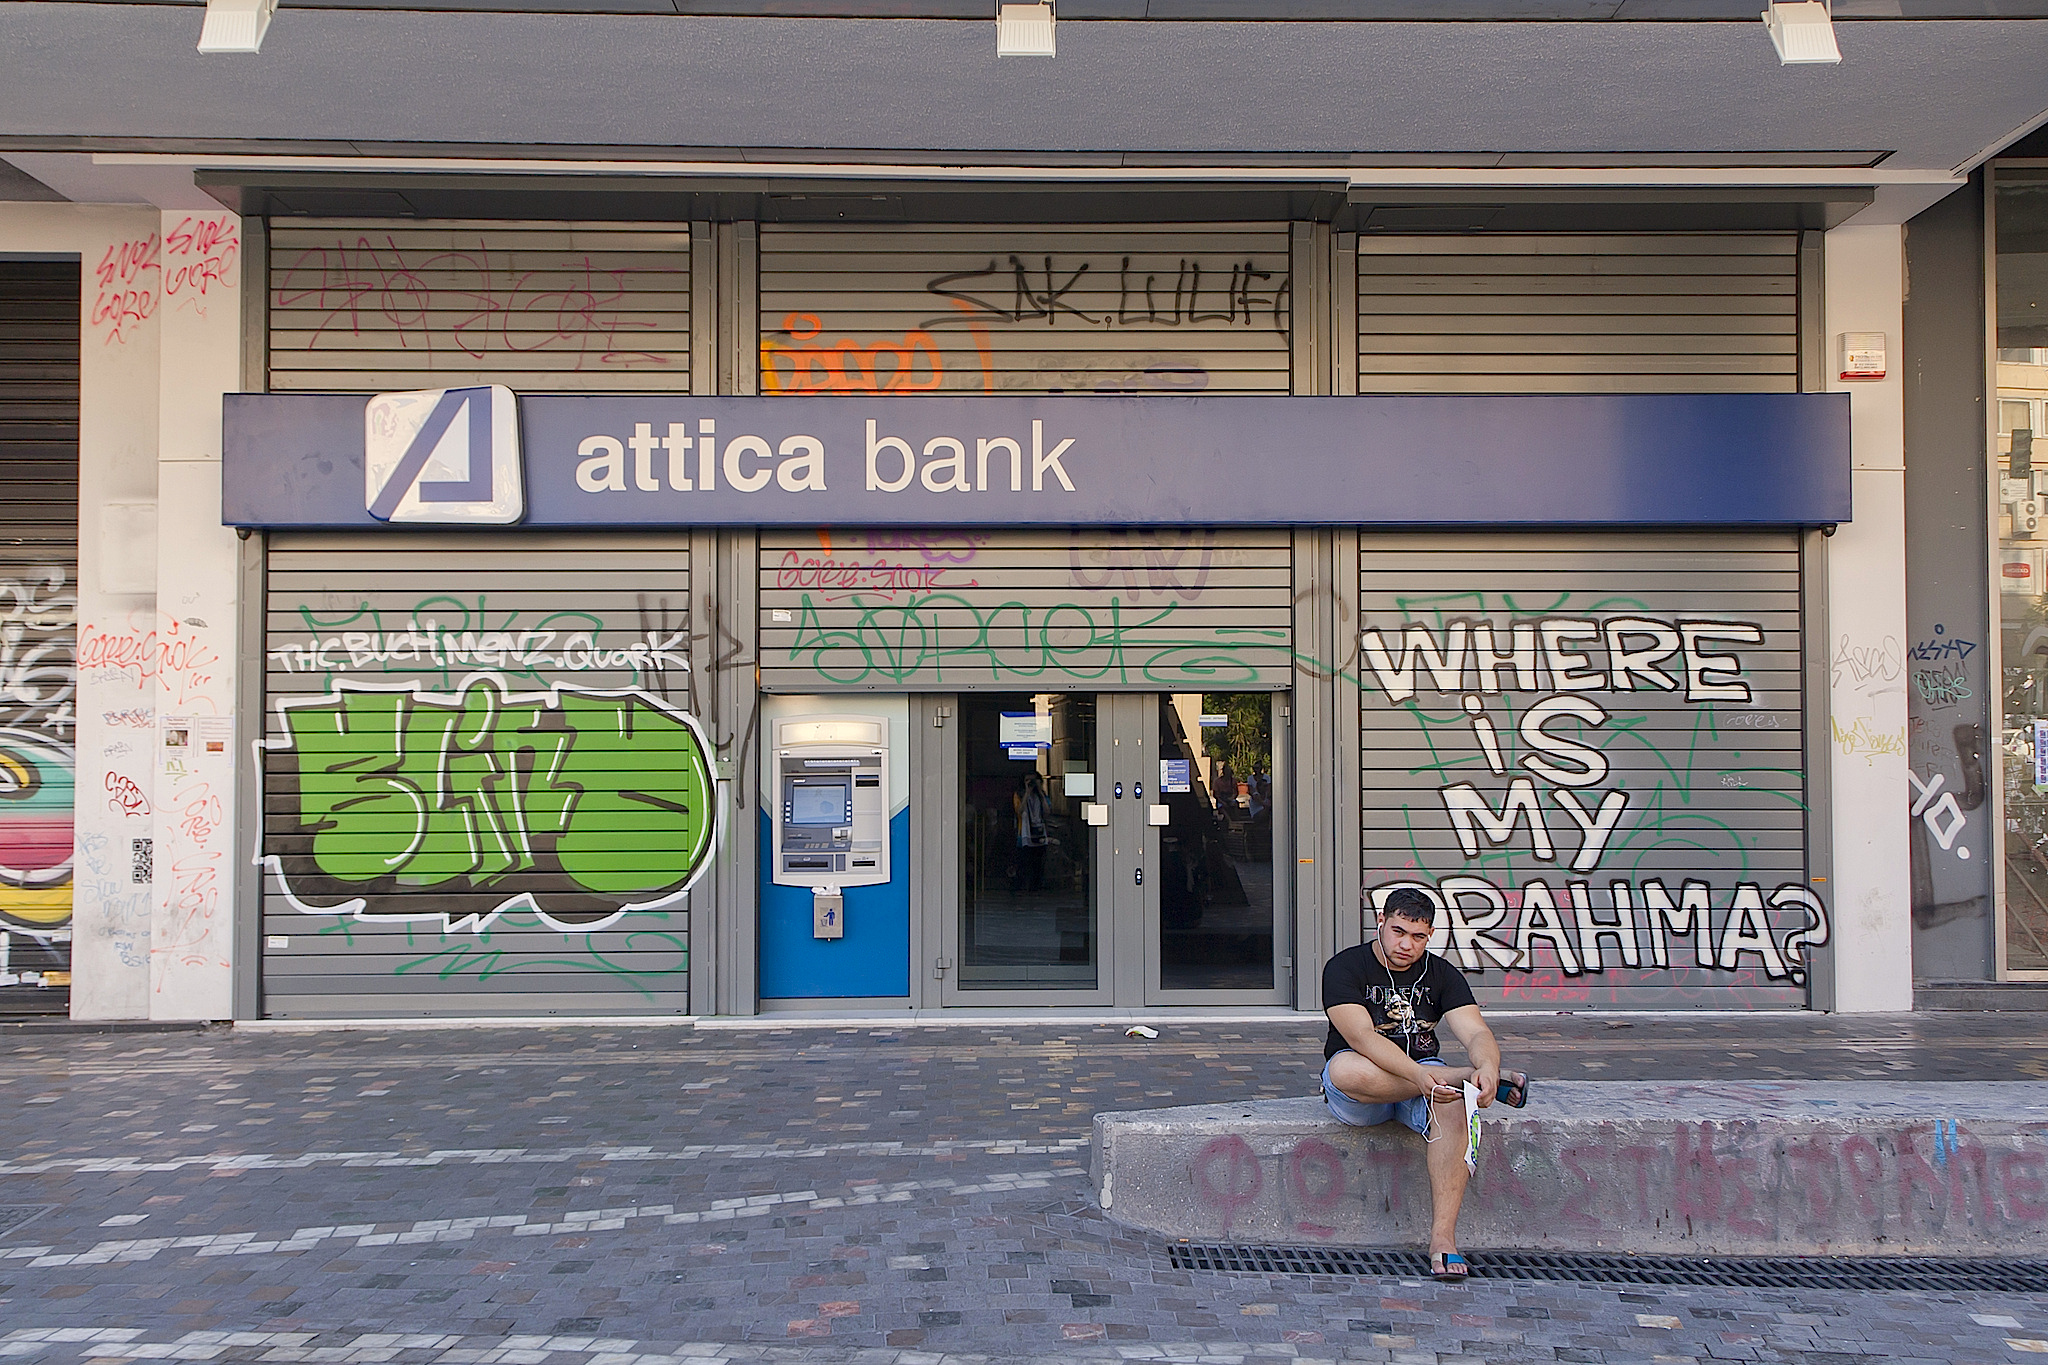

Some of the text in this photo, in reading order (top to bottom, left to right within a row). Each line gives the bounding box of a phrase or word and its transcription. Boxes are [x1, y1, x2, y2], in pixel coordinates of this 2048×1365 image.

[575, 419, 1077, 493] attica bank
[1359, 617, 1766, 706] WHERE
[1438, 775, 1630, 874] MY
